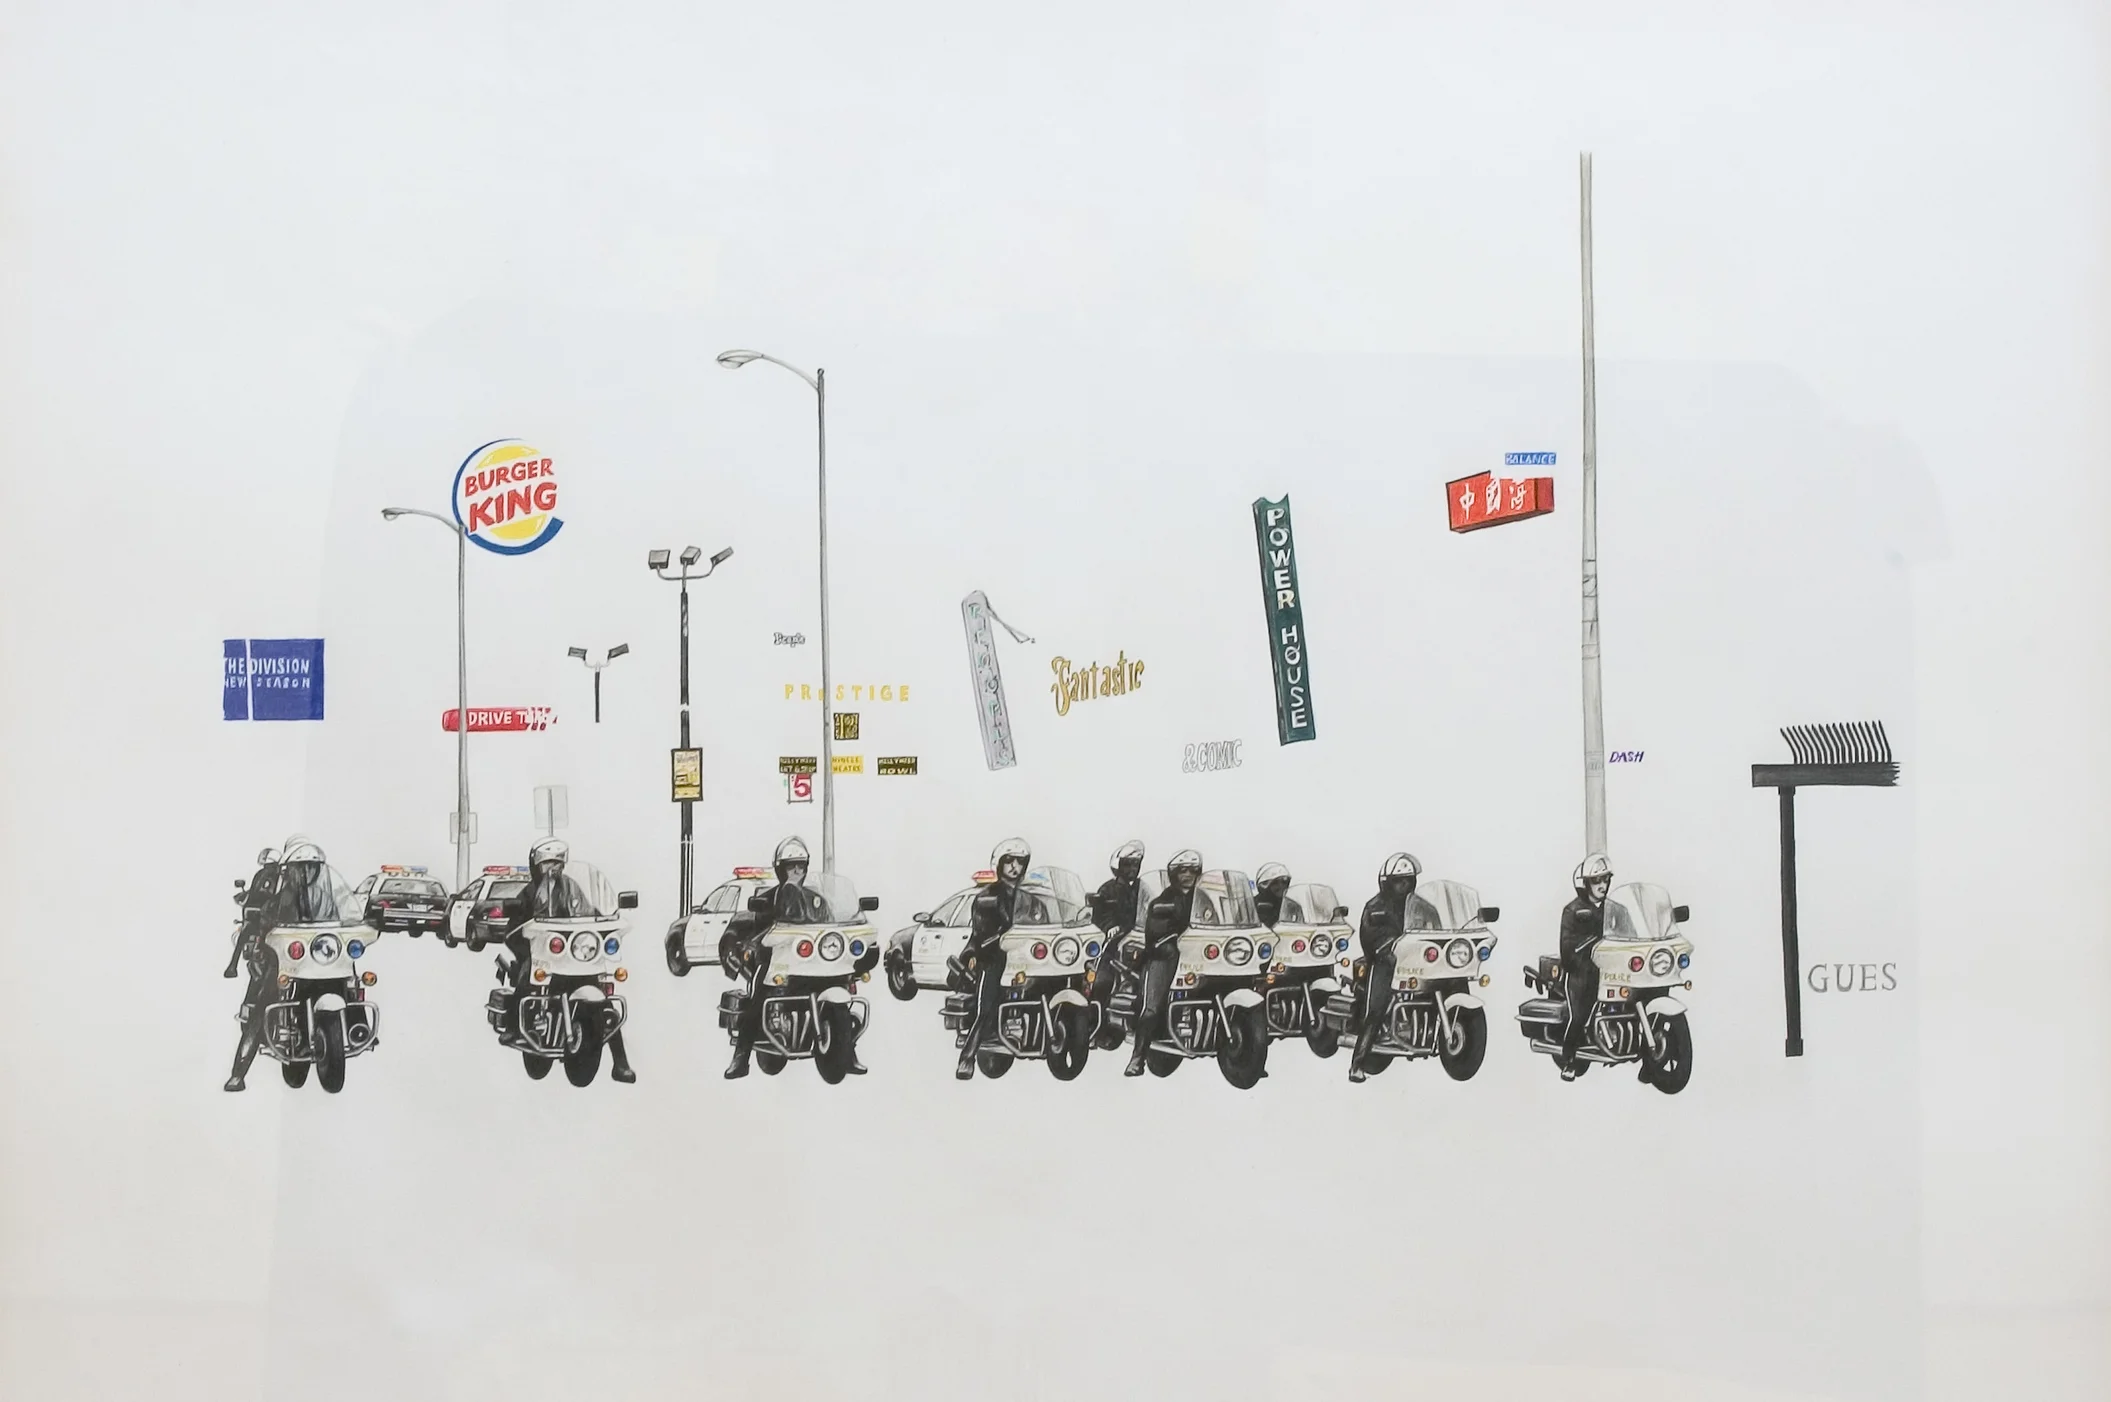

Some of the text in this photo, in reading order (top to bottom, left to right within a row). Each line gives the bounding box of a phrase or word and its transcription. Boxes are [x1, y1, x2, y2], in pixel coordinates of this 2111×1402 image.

[464, 458, 555, 498] BURGER
[469, 482, 558, 533] KING
[1266, 508, 1308, 729] POWER HOUSE
[250, 657, 310, 675] DIVISION
[468, 712, 512, 726] DRIVE
[1609, 751, 1645, 763] DASH
[1808, 963, 1898, 994] GUES
